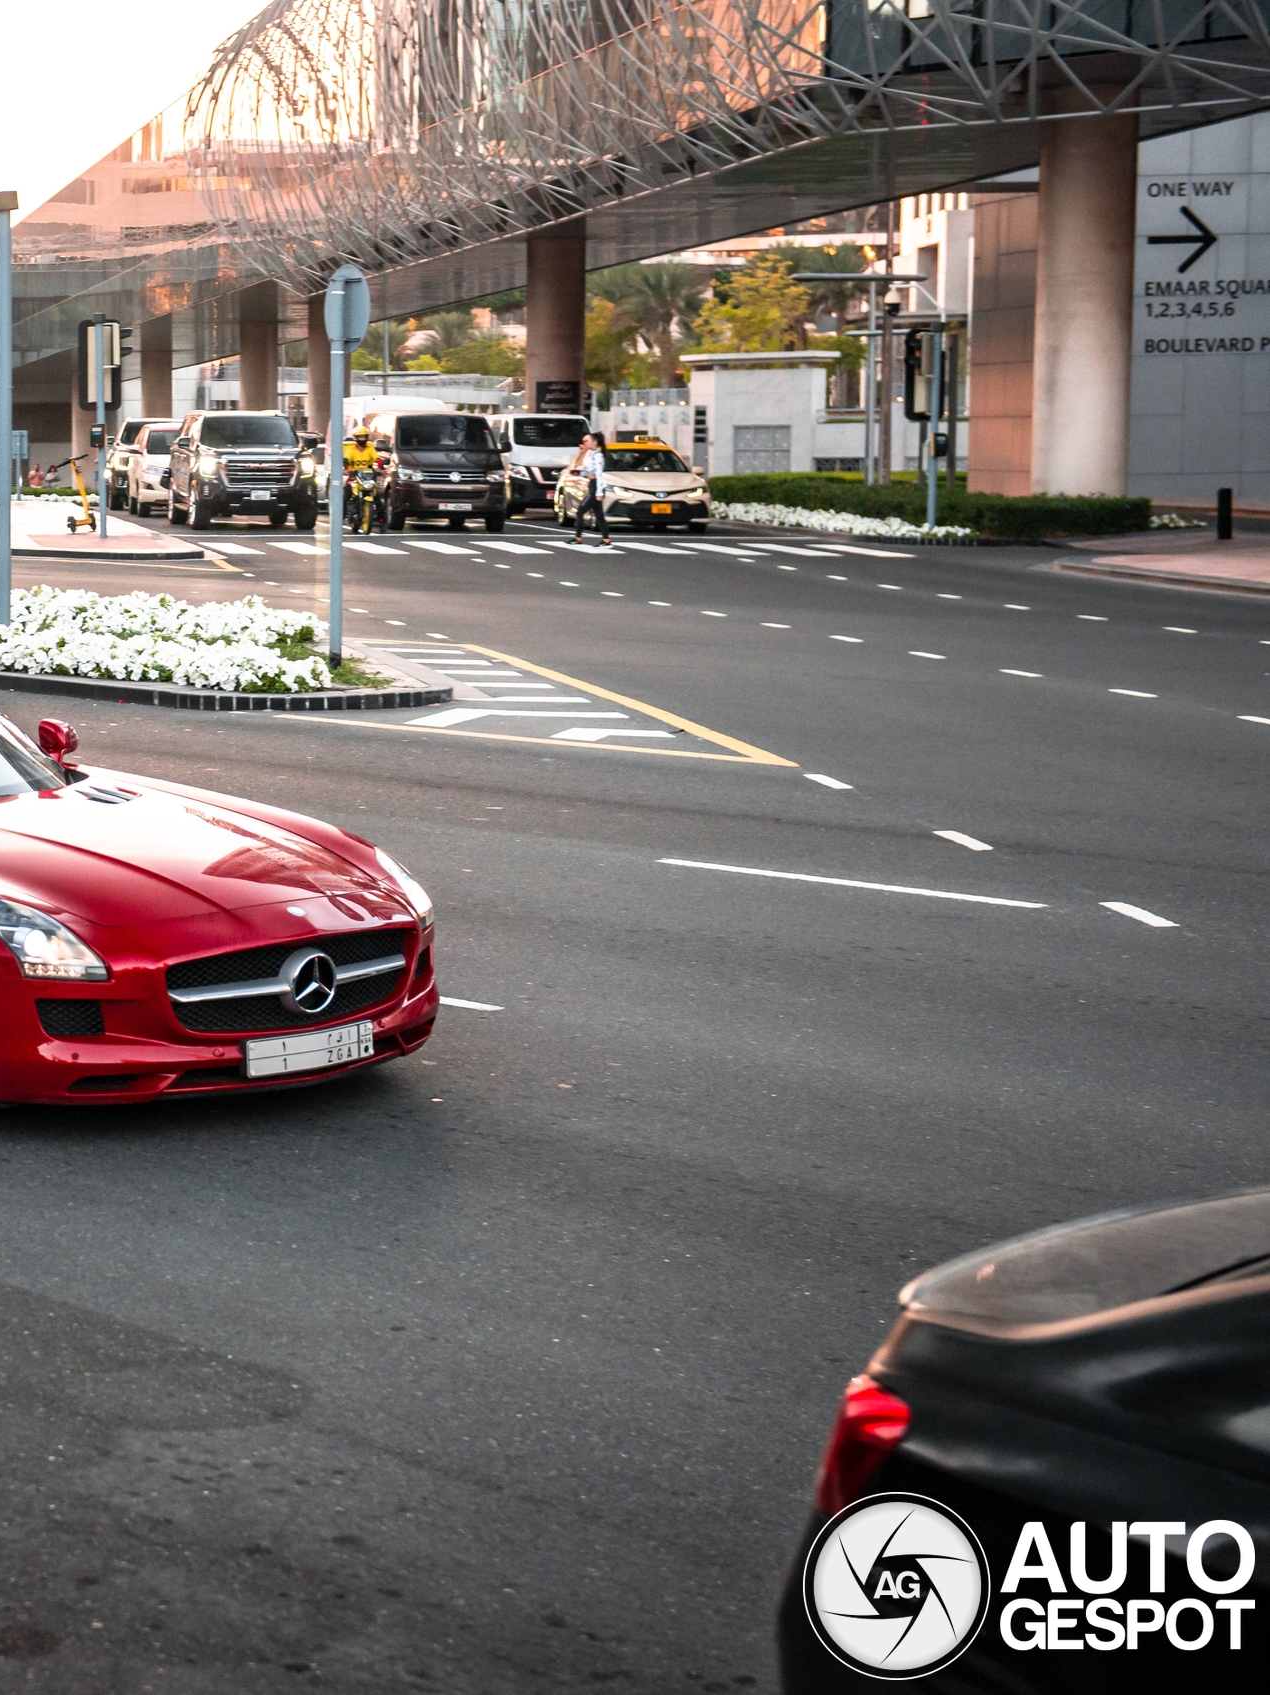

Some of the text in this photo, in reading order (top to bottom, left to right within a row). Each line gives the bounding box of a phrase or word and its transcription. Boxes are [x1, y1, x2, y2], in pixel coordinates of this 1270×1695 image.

[1147, 181, 1234, 198] ONE WAY
[1145, 279, 1270, 299] EMAAR SQUA
[1145, 302, 1236, 319] 1,2,3,4,5,6
[1145, 337, 1255, 354] BOULEVARD
